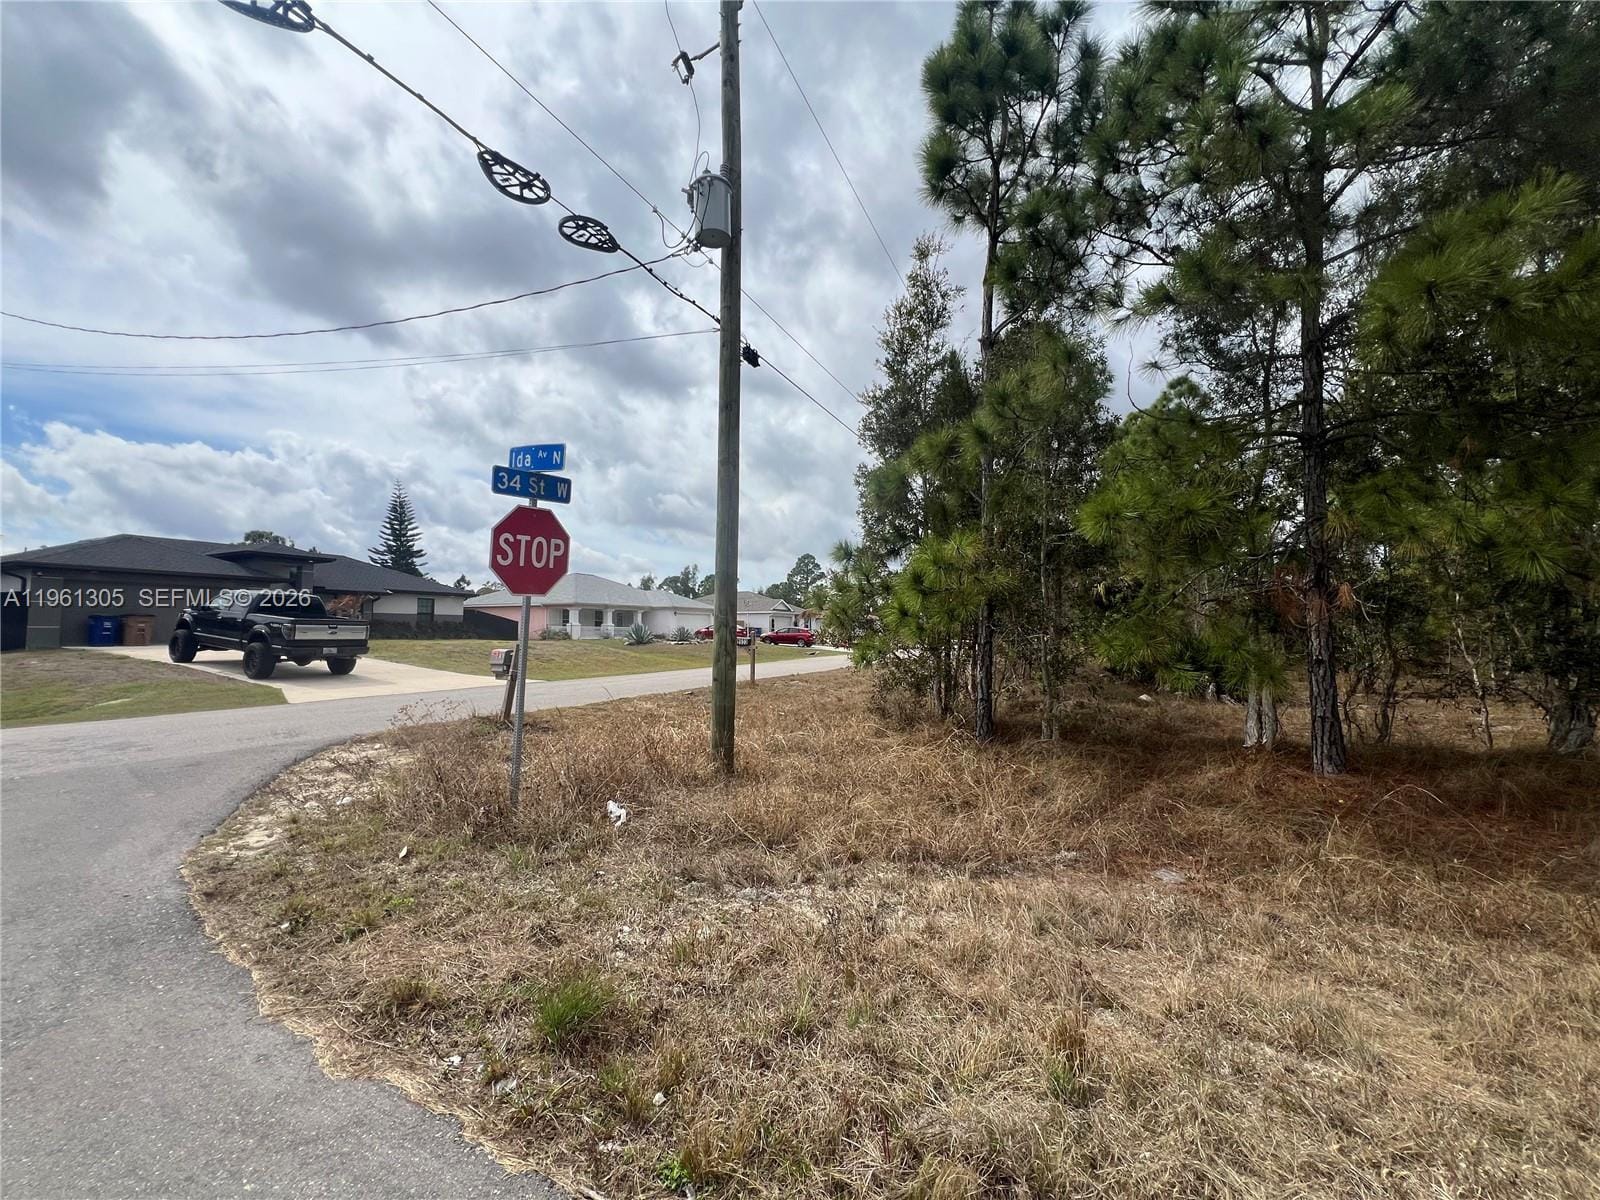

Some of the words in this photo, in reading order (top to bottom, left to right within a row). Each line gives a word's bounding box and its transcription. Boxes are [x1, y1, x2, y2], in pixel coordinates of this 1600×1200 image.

[511, 451, 531, 468] Ida
[538, 450, 548, 458] Av
[552, 450, 561, 465] N
[497, 472, 521, 491] 34
[528, 477, 545, 496] St
[557, 481, 568, 498] W
[496, 532, 565, 569] STOP
